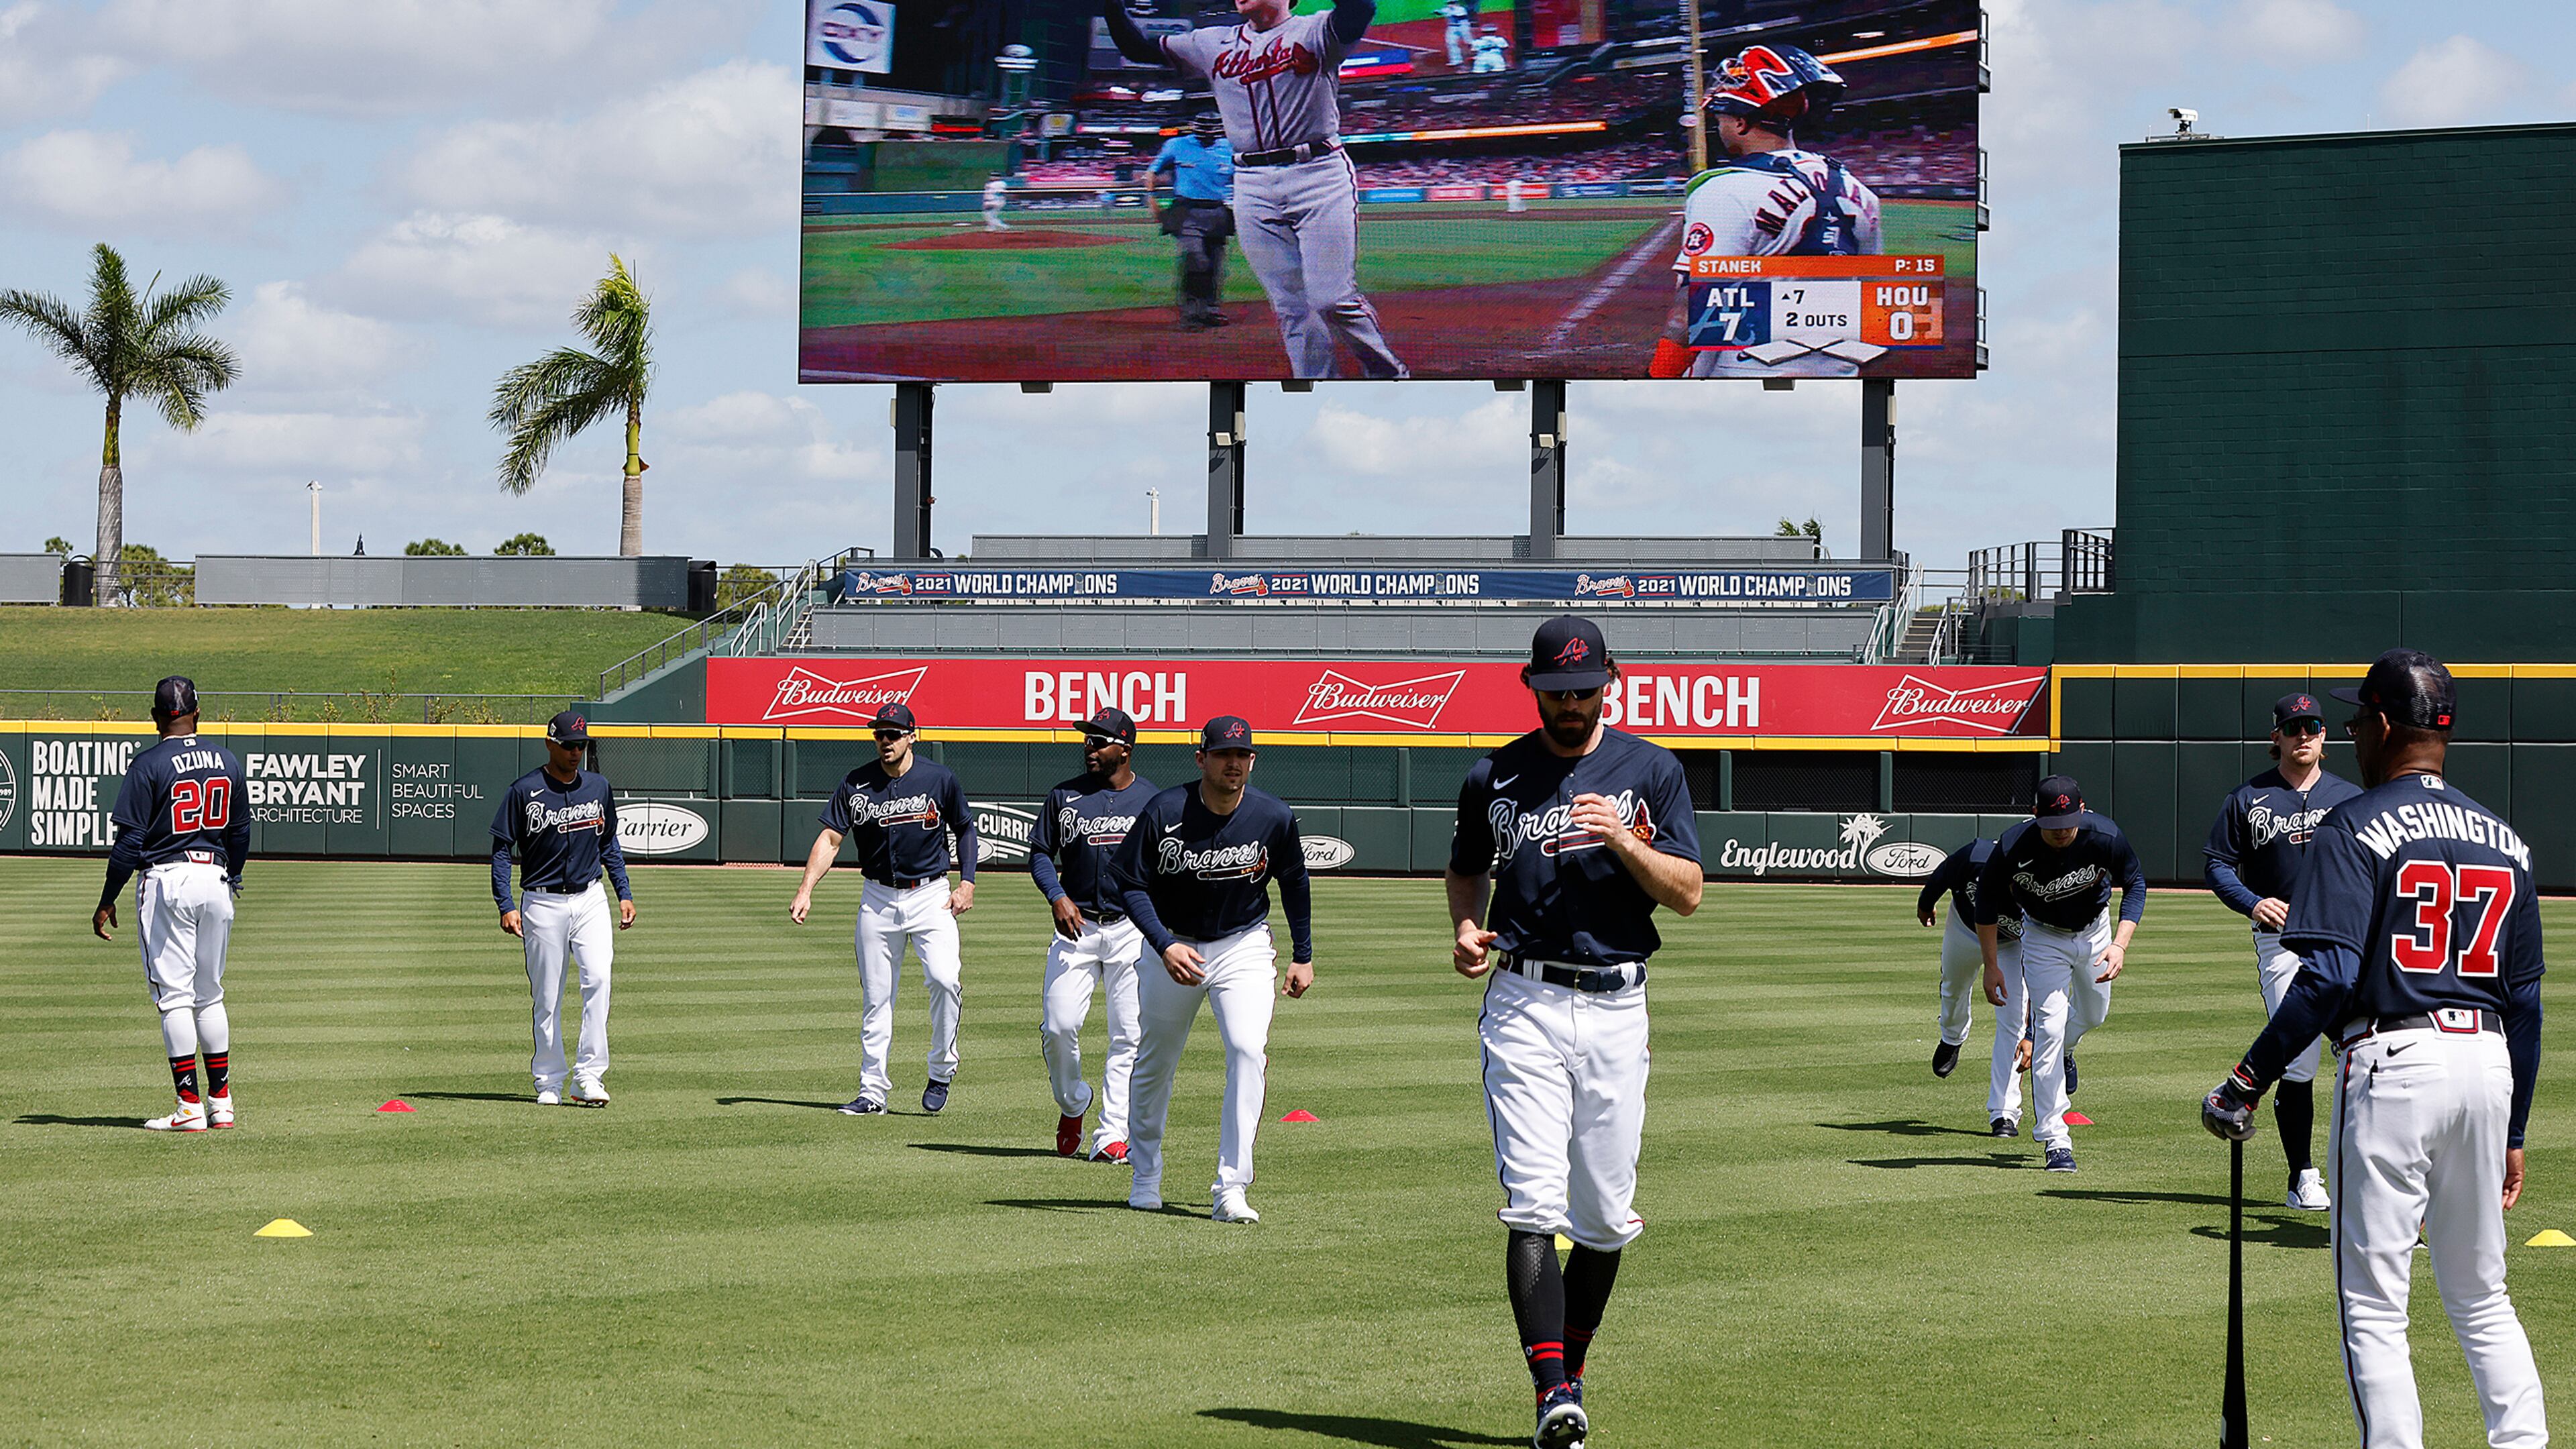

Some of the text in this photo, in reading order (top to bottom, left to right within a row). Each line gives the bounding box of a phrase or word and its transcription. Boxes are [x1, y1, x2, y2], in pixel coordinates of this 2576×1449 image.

[1698, 260, 1762, 274] STANEK
[1895, 259, 1935, 272] P: 15
[1706, 288, 1755, 307] ATL
[1876, 286, 1929, 307] HOU
[1718, 313, 1742, 341] 7
[1785, 312, 1847, 327] 2 OUTS
[1889, 311, 1913, 341] 0
[855, 572, 904, 594] Braves
[915, 578, 951, 590] 2021
[953, 574, 1013, 594] WORLD
[1210, 573, 1260, 594] Braves
[1271, 578, 1308, 590] 2021
[1311, 574, 1371, 594] WORLD
[1574, 574, 1625, 596] Braves
[1638, 579, 1676, 592] 2021
[1678, 576, 1740, 596] WORLD
[777, 679, 909, 706] Budweiser
[1024, 671, 1187, 722] BENCH
[1308, 682, 1446, 710] Budweiser
[1599, 675, 1760, 728] BENCH
[1886, 688, 2029, 715] Budweiser
[32, 741, 133, 776] BOATING
[170, 750, 225, 774] OZUNA
[246, 753, 366, 779] FAWLEY
[392, 763, 450, 779] SMART
[32, 775, 99, 810] MADE
[170, 775, 232, 835] 20
[246, 780, 366, 806] BRYANT
[392, 783, 484, 799] BEAUTIFUL
[249, 807, 363, 823] ARCHITECTURE
[391, 803, 455, 819] SPACES
[525, 800, 601, 837] Braves
[849, 793, 927, 826] Braves
[31, 811, 119, 847] SIMPLE
[1059, 806, 1136, 848] Brave
[1488, 789, 1633, 860] Bras
[2247, 806, 2332, 850] Brav
[2355, 802, 2530, 872] WASHINGTON
[1157, 837, 1259, 875] Braves
[1720, 839, 1859, 876] Englewood
[1884, 848, 1931, 869] Ford
[2012, 863, 2096, 896] Braves
[2391, 859, 2516, 977] 37
